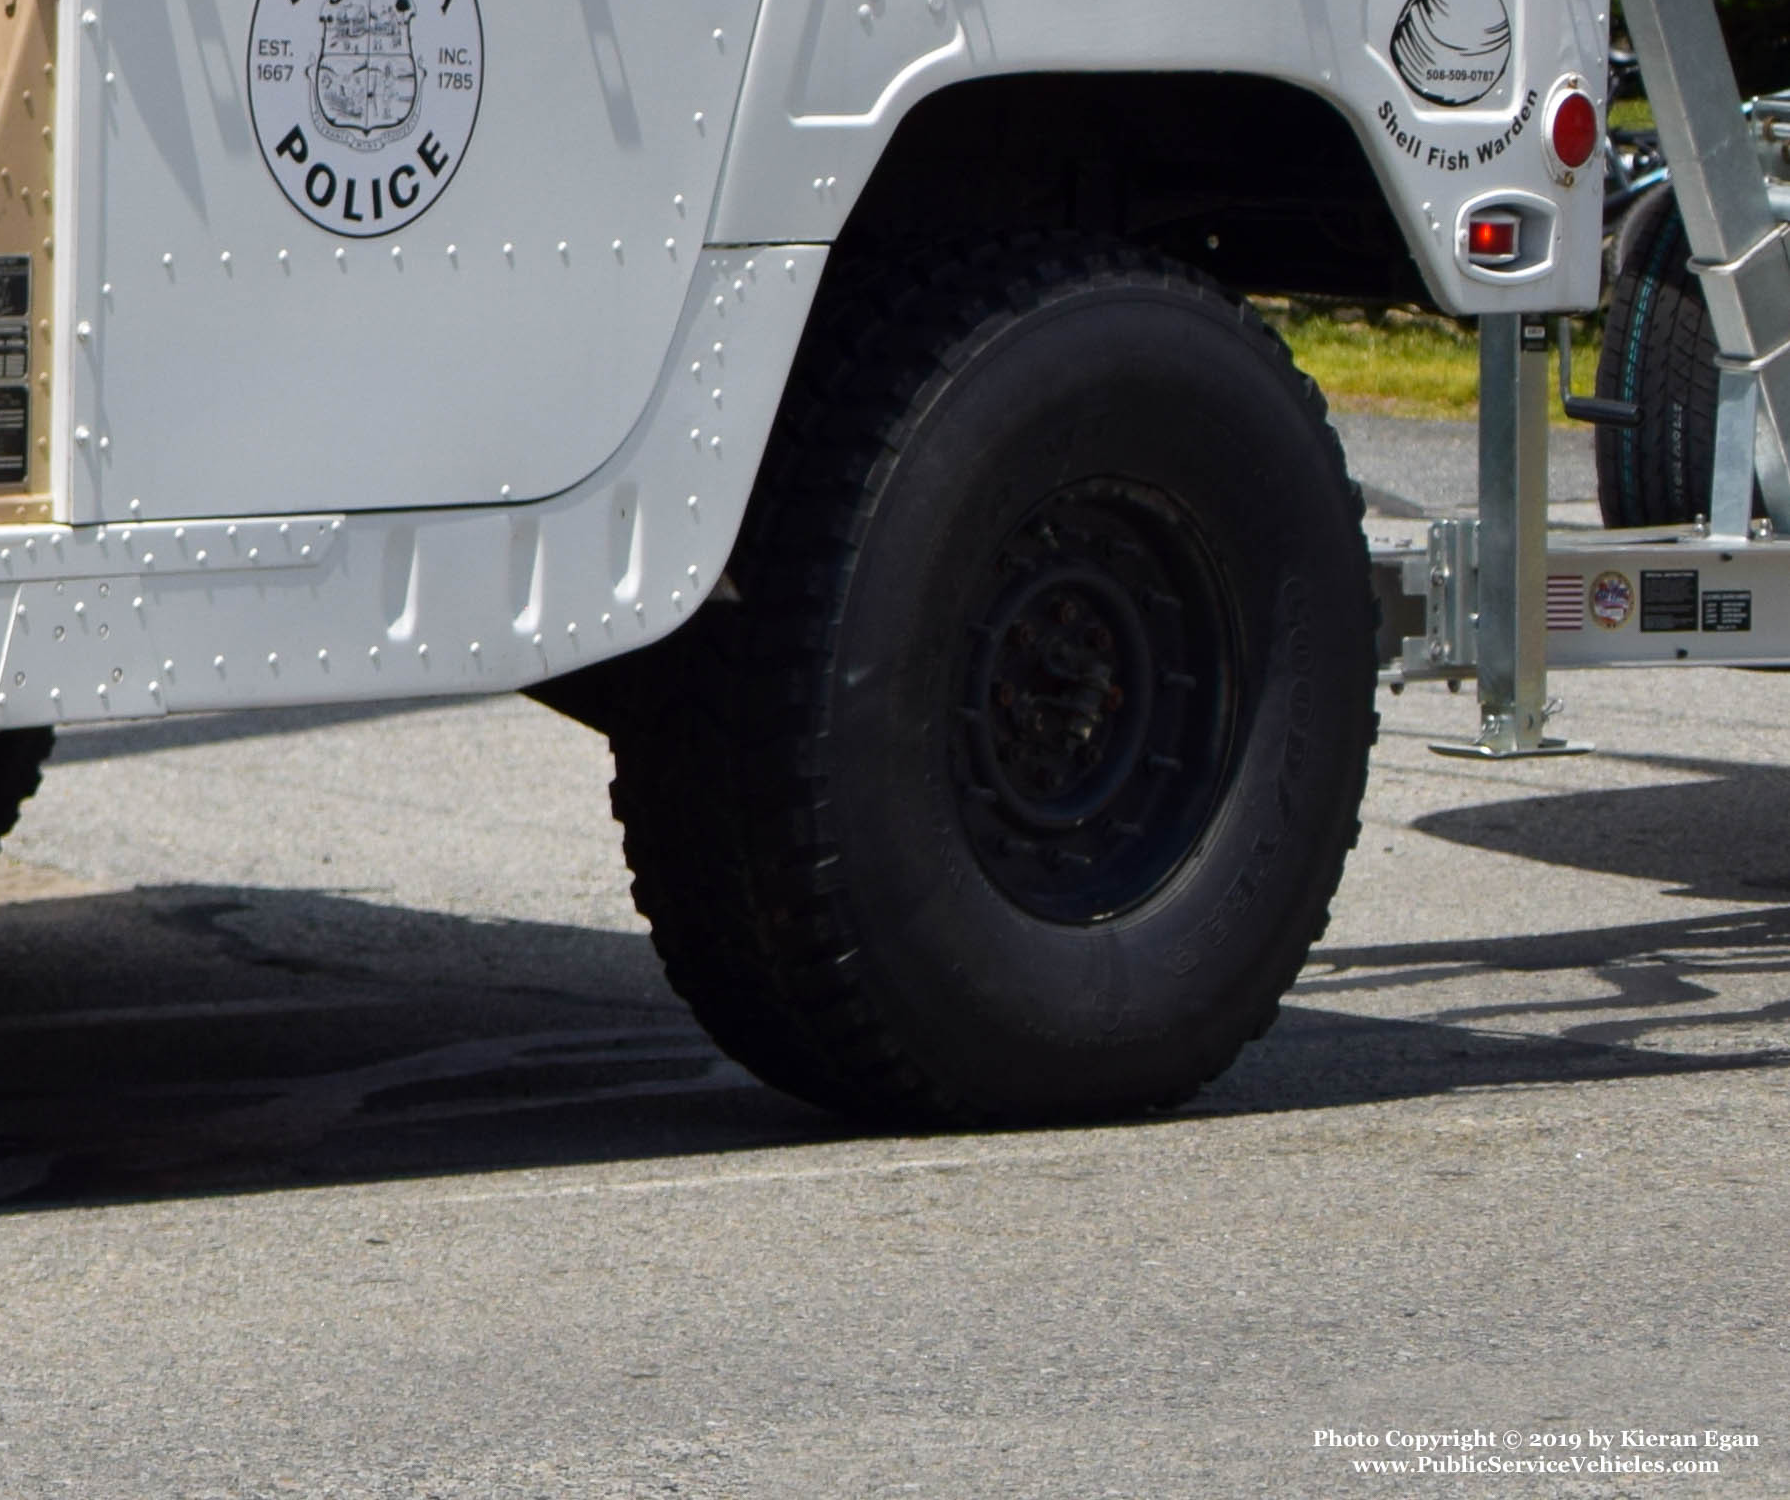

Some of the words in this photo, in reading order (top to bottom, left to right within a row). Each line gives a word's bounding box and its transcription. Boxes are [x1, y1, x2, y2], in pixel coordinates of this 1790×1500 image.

[258, 39, 294, 57] EST.
[438, 47, 473, 66] INC.
[257, 65, 293, 81] 1667
[438, 73, 474, 91] 1785
[1378, 100, 1422, 158] Shell
[1427, 146, 1470, 171] Fish
[1476, 88, 1539, 166] Warden
[276, 125, 450, 222] POLICE
